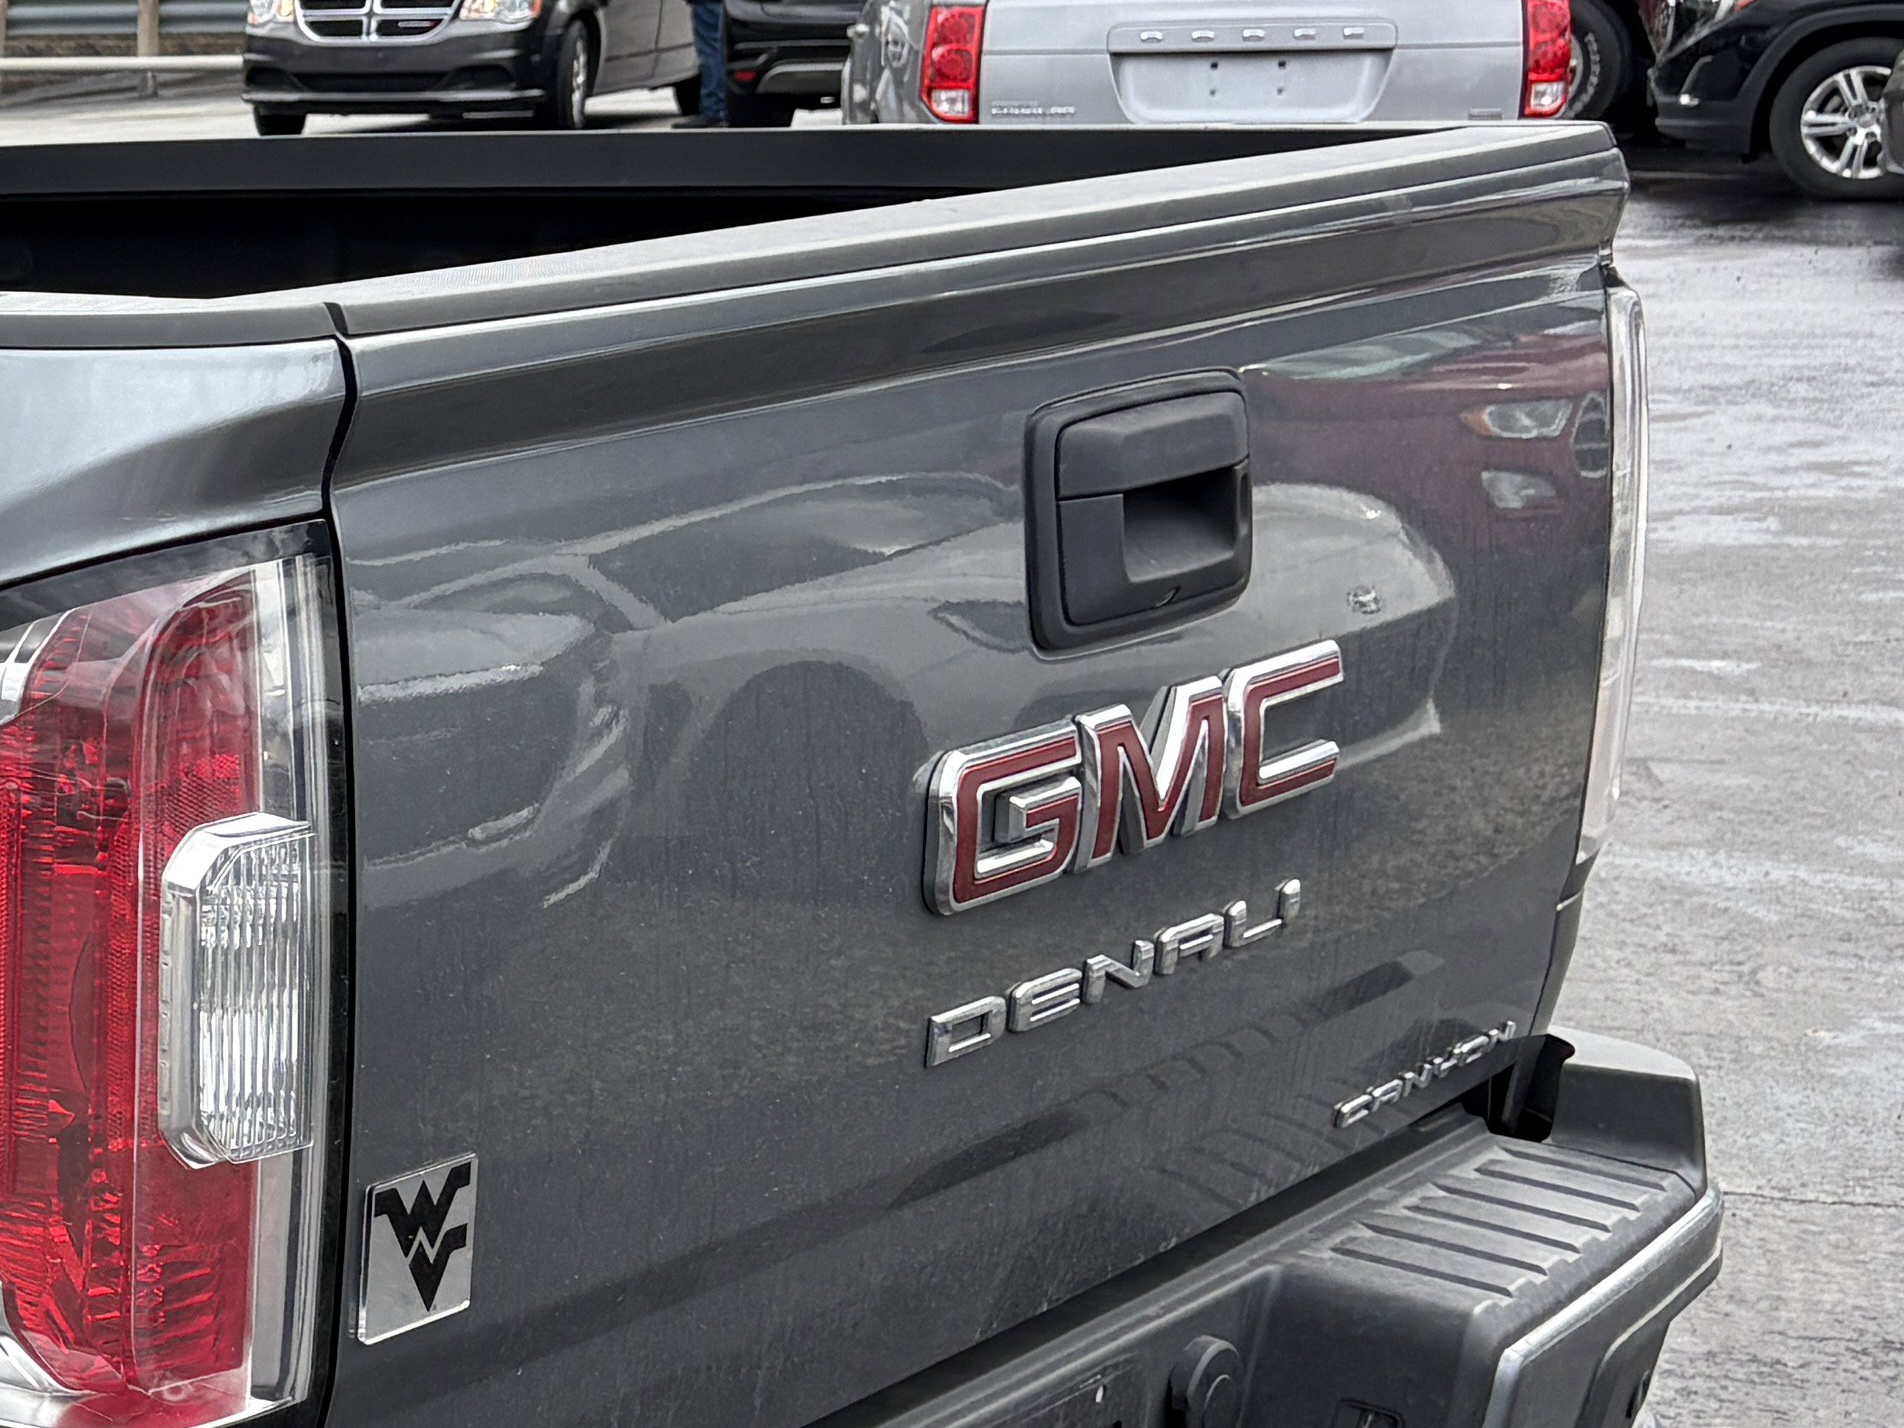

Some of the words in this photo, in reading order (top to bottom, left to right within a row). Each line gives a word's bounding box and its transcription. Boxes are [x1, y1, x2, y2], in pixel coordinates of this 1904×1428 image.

[919, 639, 1344, 916] GMC
[925, 878, 1301, 1068] DENALI
[1332, 1020, 1516, 1128] CANYON
